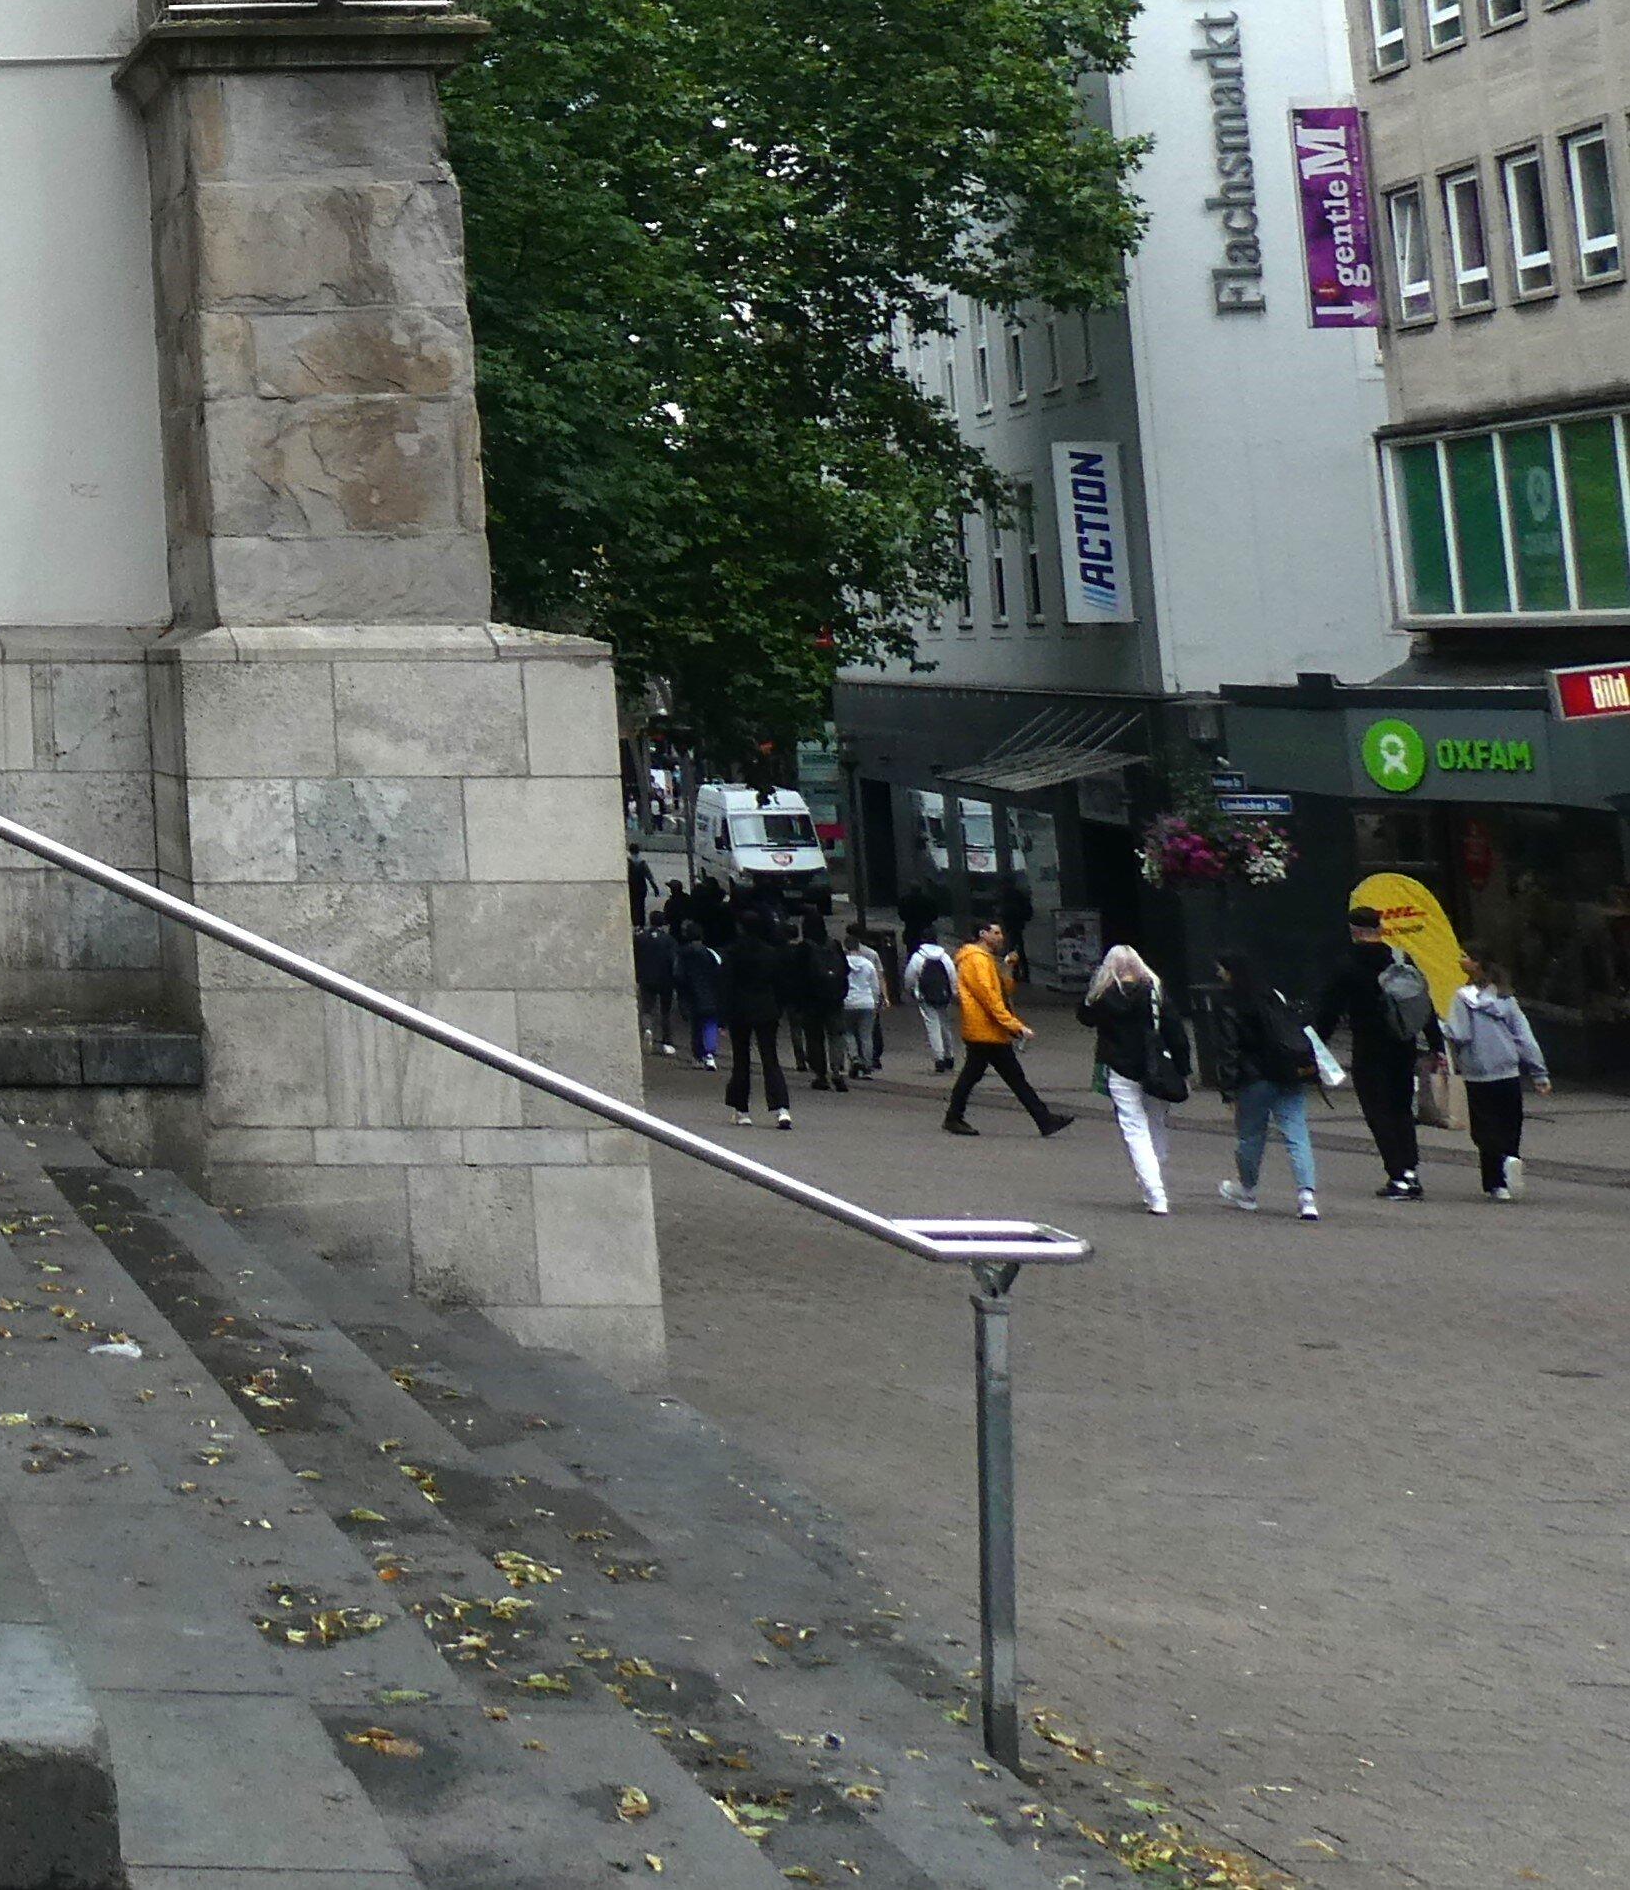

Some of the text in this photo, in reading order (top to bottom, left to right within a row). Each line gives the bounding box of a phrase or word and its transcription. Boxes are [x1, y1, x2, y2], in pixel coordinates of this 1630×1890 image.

[1191, 10, 1267, 317] Flachsmarkt
[1069, 451, 1116, 590] ACTION
[1589, 672, 1630, 709] Bild
[1435, 737, 1533, 773] OXFAM
